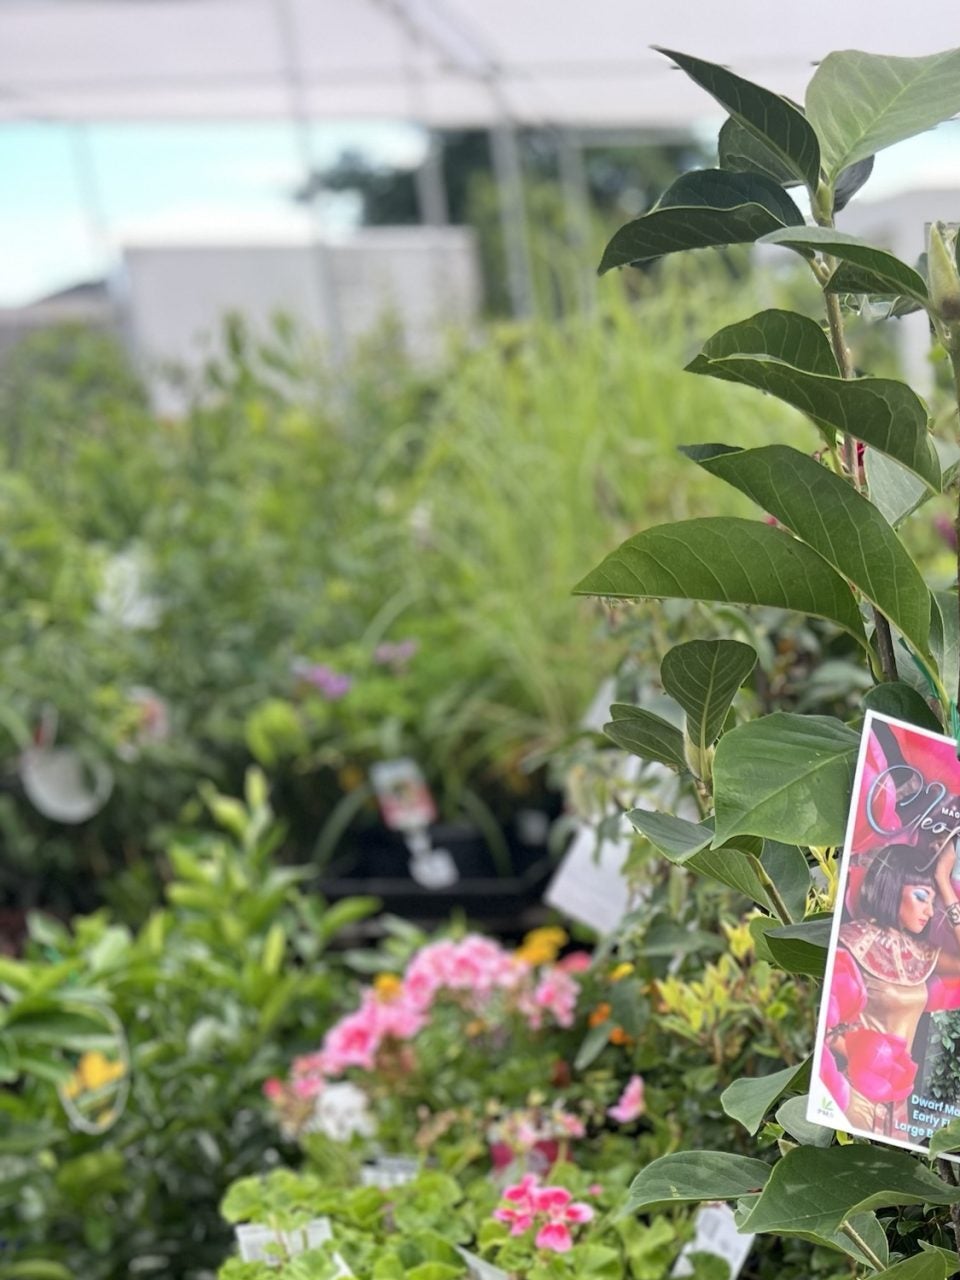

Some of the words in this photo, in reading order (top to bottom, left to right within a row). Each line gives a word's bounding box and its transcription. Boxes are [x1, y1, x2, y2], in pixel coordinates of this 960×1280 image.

[912, 1095, 944, 1111] Dwarf
[912, 1110, 940, 1128] Early
[895, 1120, 925, 1137] Large
